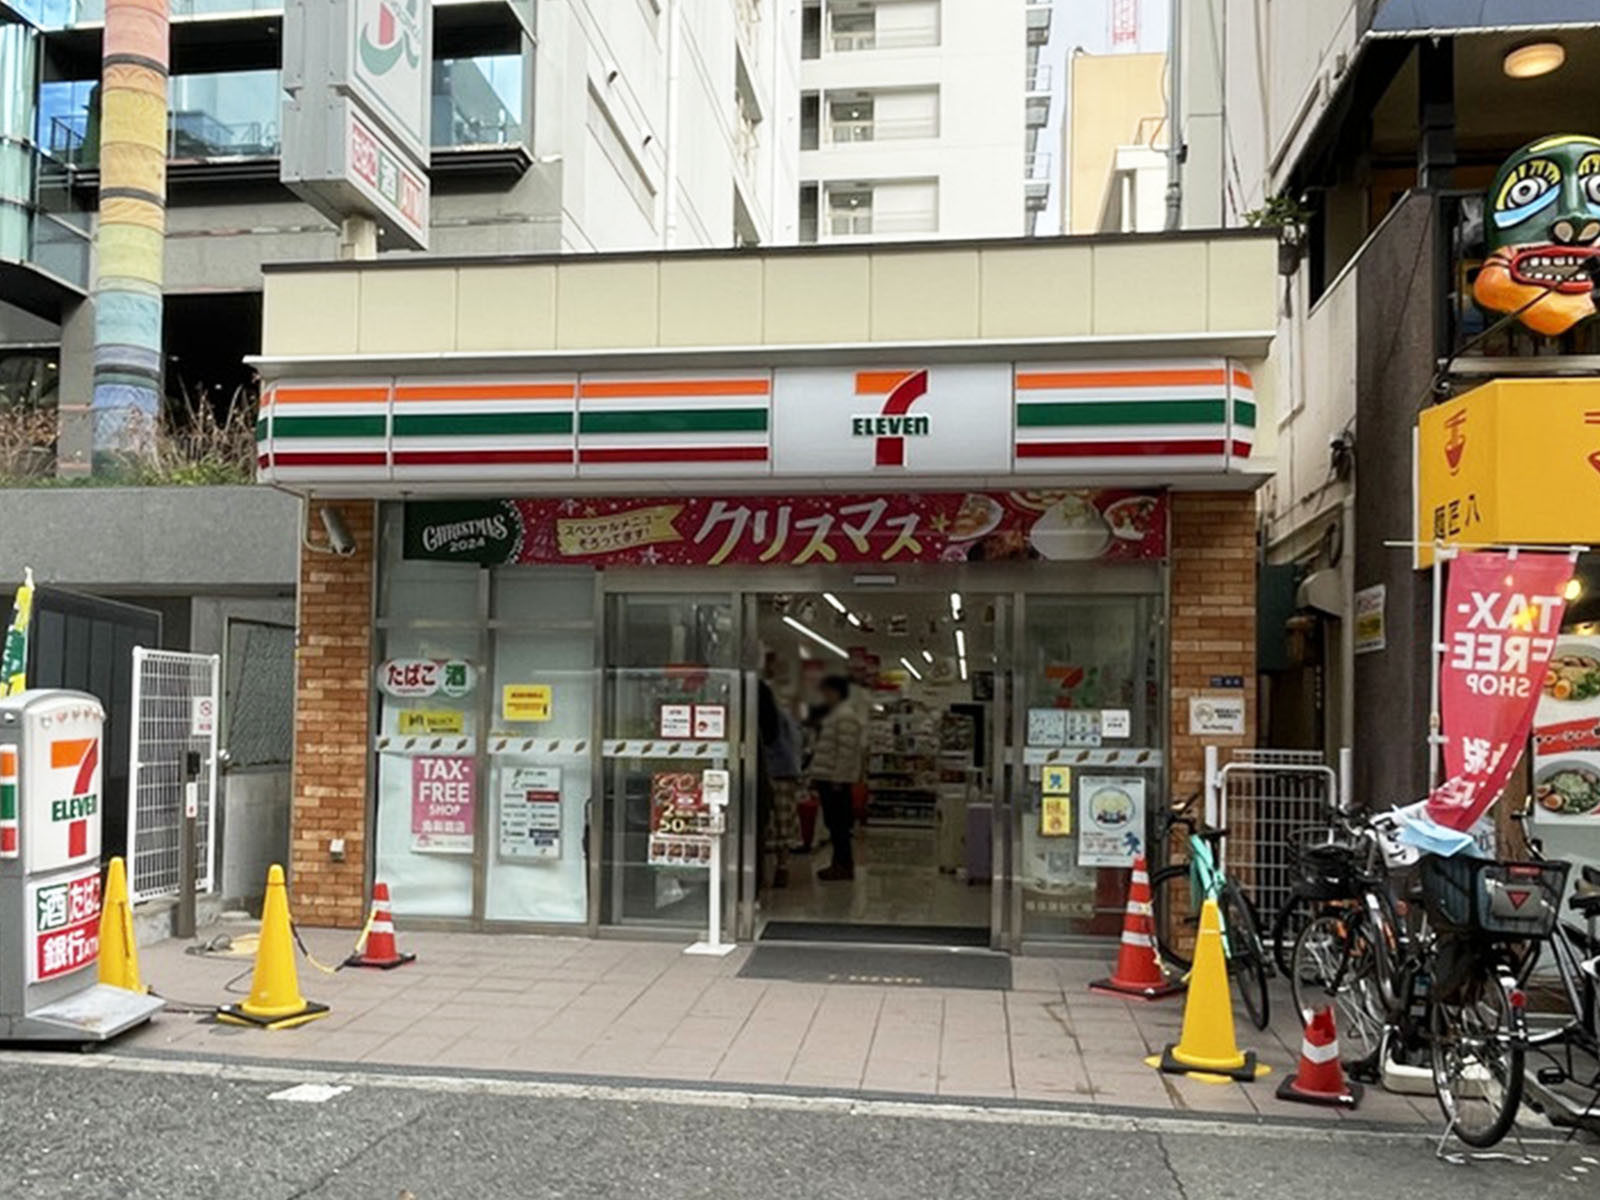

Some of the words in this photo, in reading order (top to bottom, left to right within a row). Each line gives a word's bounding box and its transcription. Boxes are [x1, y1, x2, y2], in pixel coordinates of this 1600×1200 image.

[855, 370, 928, 467] 7
[694, 498, 924, 565] クリスマス
[449, 537, 486, 553] 2024
[387, 663, 436, 687] たばこ
[444, 663, 467, 687] 酒
[420, 759, 470, 780] TAX-
[51, 738, 98, 858] 7
[419, 781, 470, 803] FREE
[428, 804, 461, 817] SHOP
[38, 884, 68, 930] 酒
